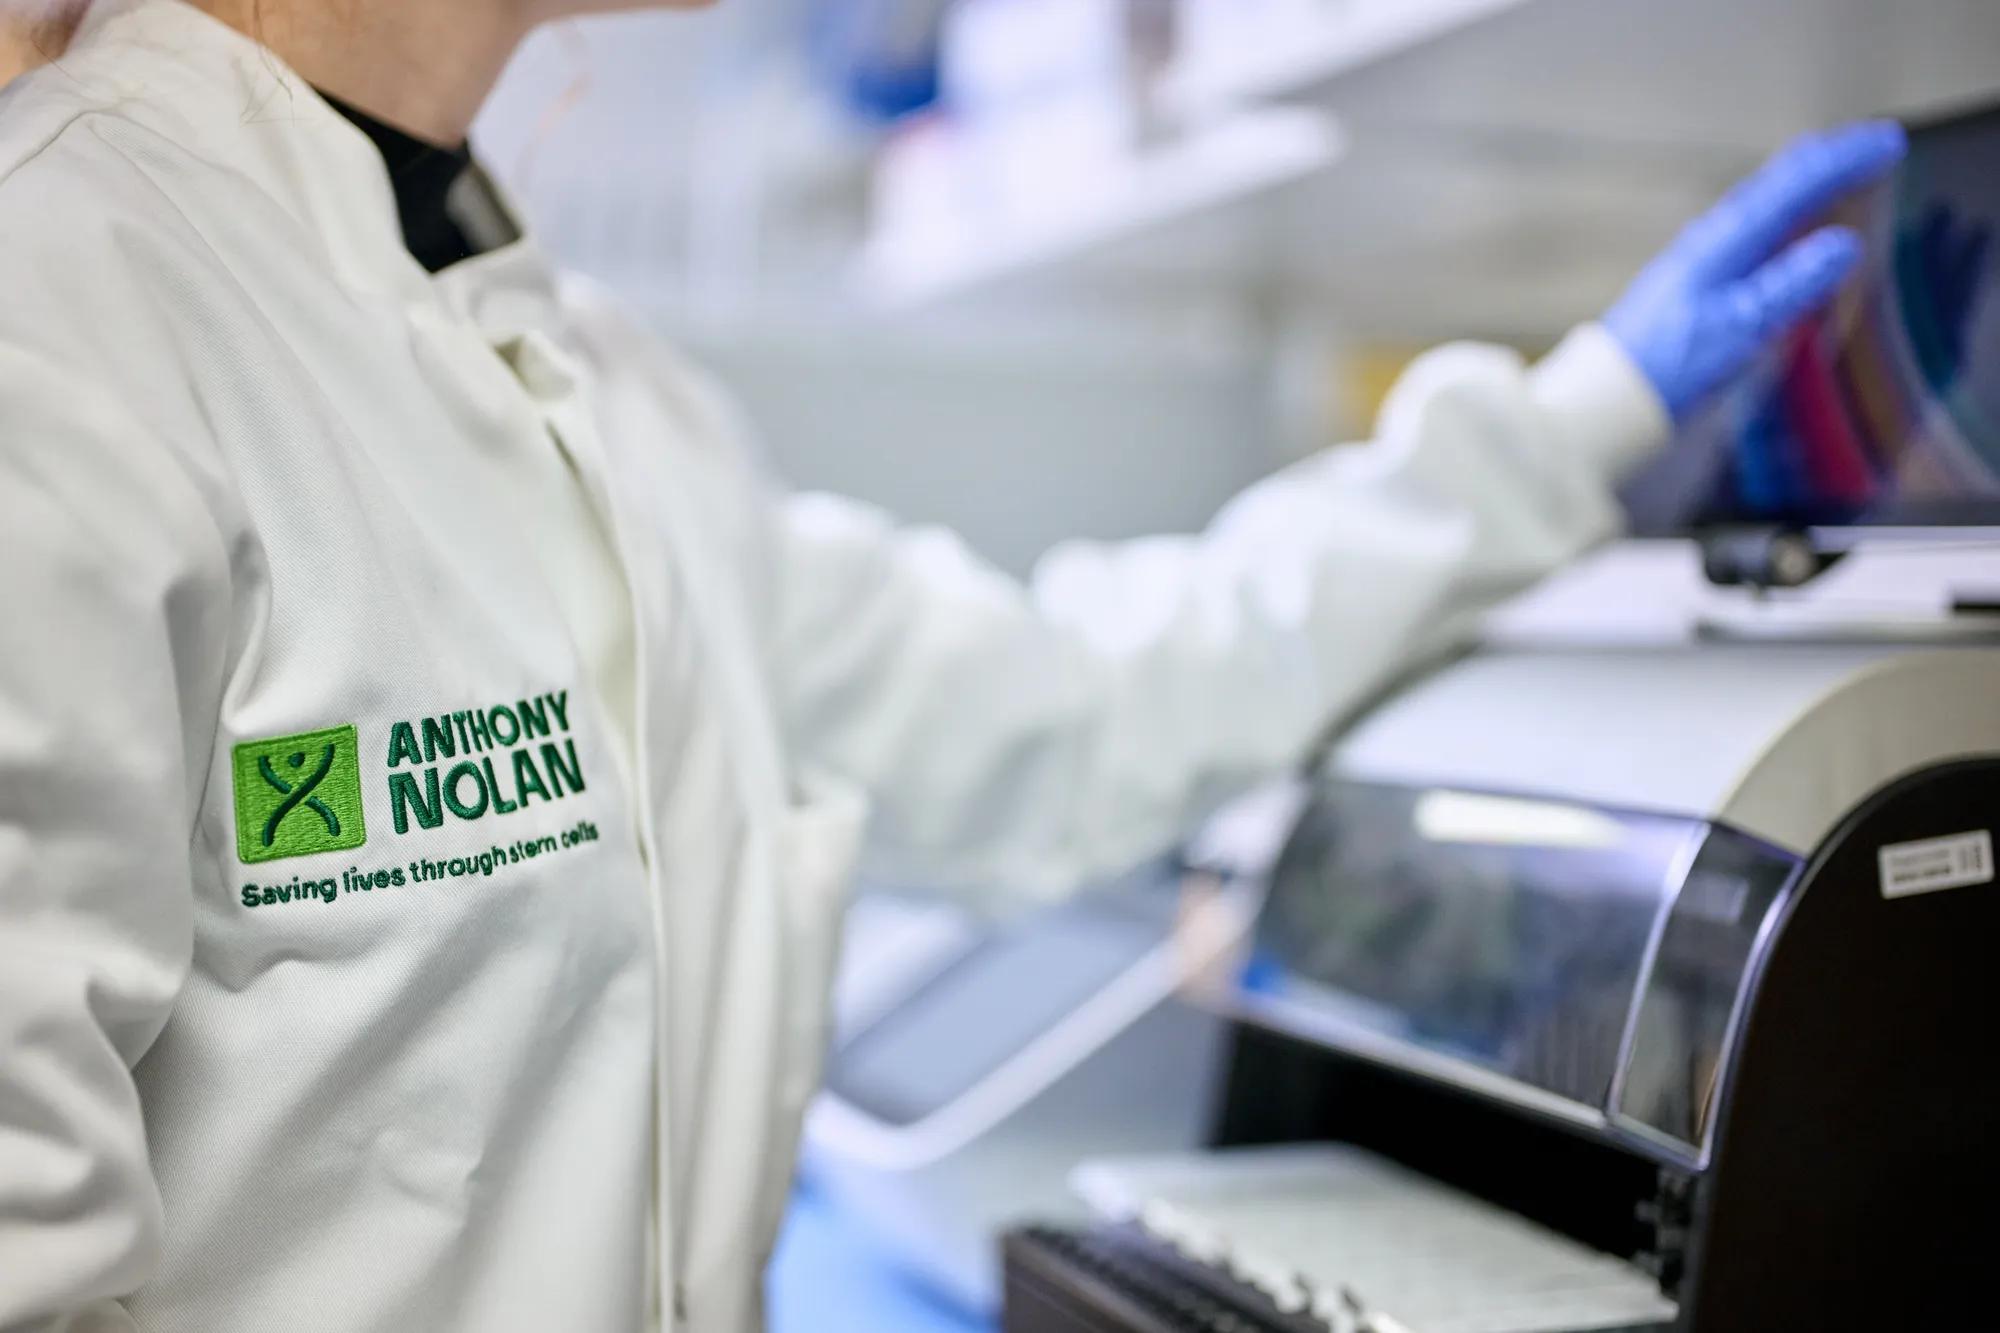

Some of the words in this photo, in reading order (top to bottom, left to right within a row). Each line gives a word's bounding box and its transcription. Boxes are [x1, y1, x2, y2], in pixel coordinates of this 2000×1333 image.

[387, 690, 569, 767] ANTHONY
[388, 738, 586, 834] NOLAN
[241, 876, 337, 907] Saving
[344, 865, 406, 893] lives
[410, 845, 507, 883] through
[561, 820, 599, 849] cells
